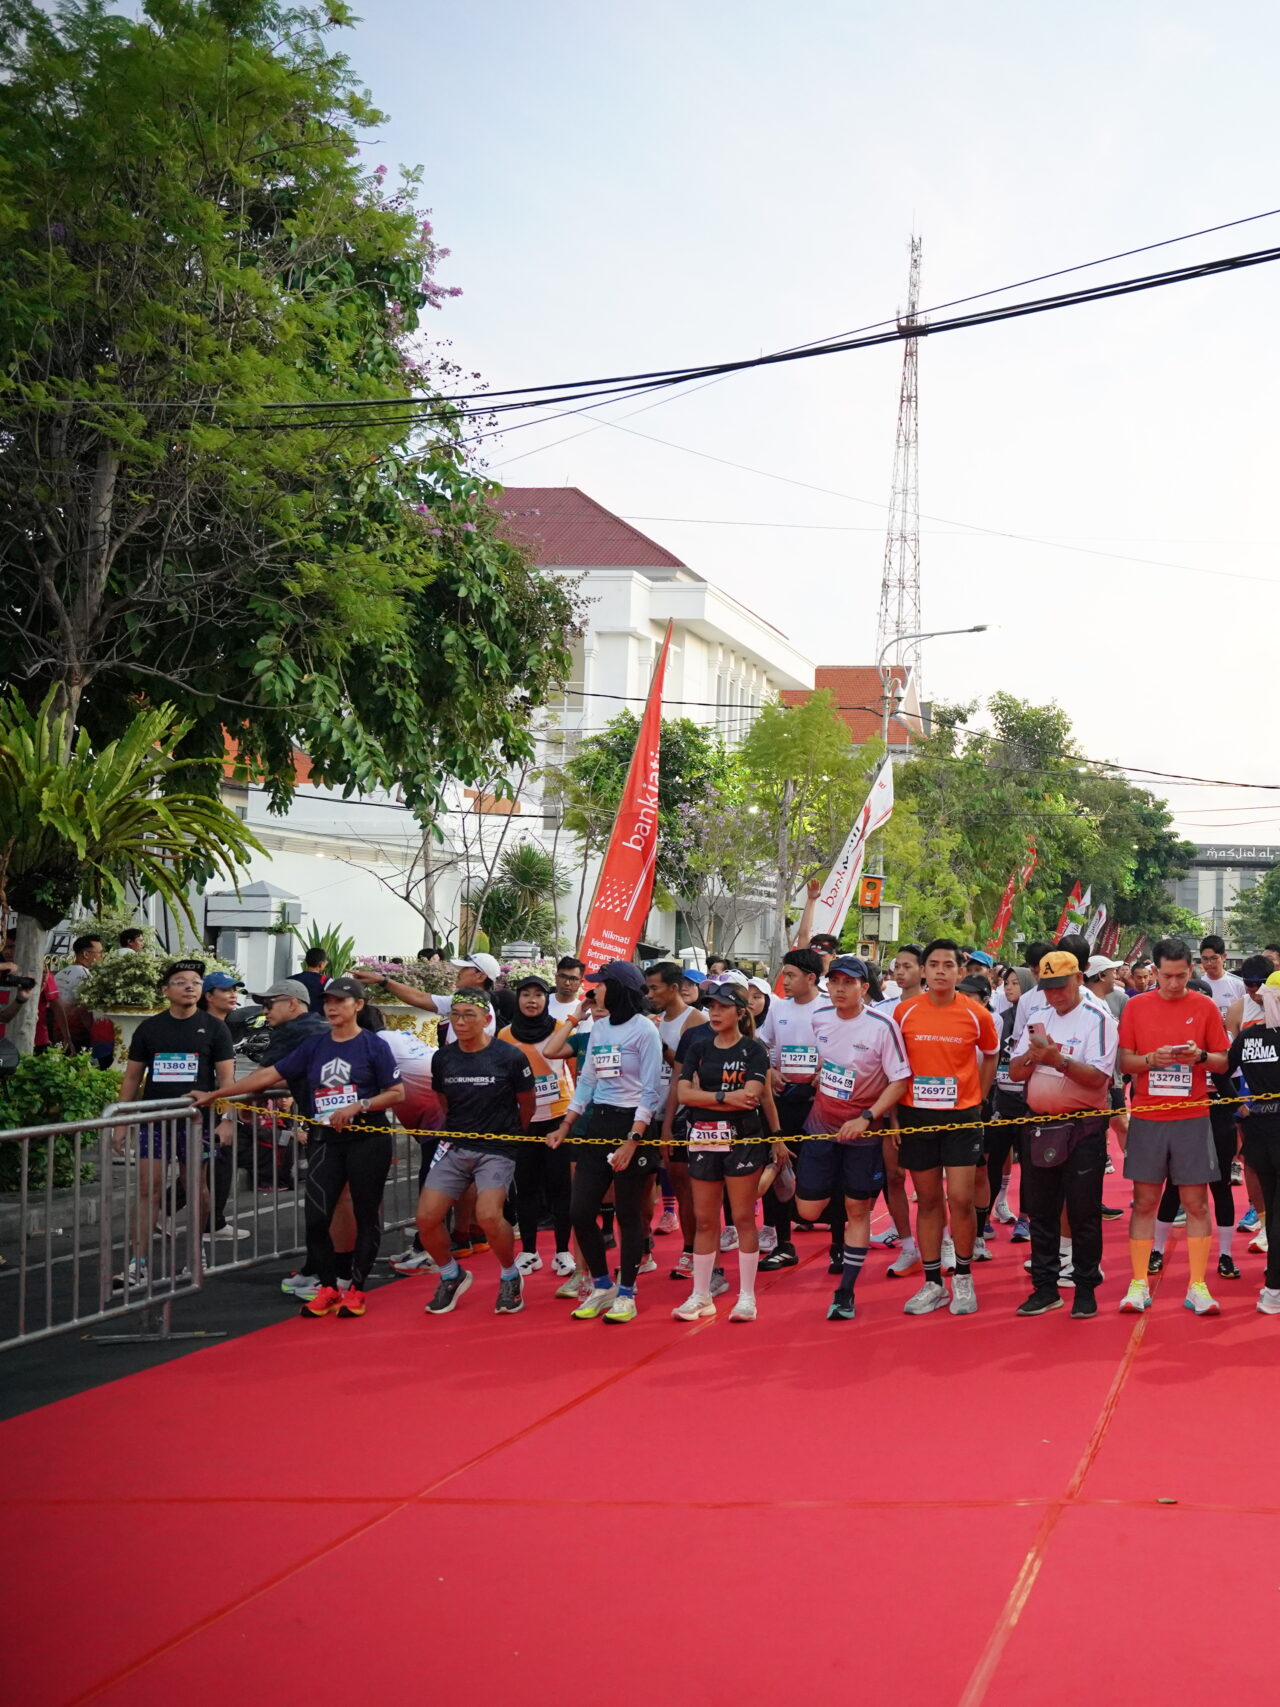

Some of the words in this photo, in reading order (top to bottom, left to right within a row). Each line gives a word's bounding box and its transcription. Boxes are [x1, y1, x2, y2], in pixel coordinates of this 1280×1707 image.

[602, 929, 631, 944] Nikmati
[643, 962, 652, 971] P
[1043, 961, 1055, 975] A
[1244, 1038, 1263, 1048] WANI
[1241, 1045, 1277, 1061] DRAMA
[825, 1072, 843, 1085] 1484
[1156, 1073, 1181, 1082] 3278
[921, 1086, 945, 1094] 2697
[321, 1096, 345, 1106] 1302
[696, 1131, 718, 1140] 2116
